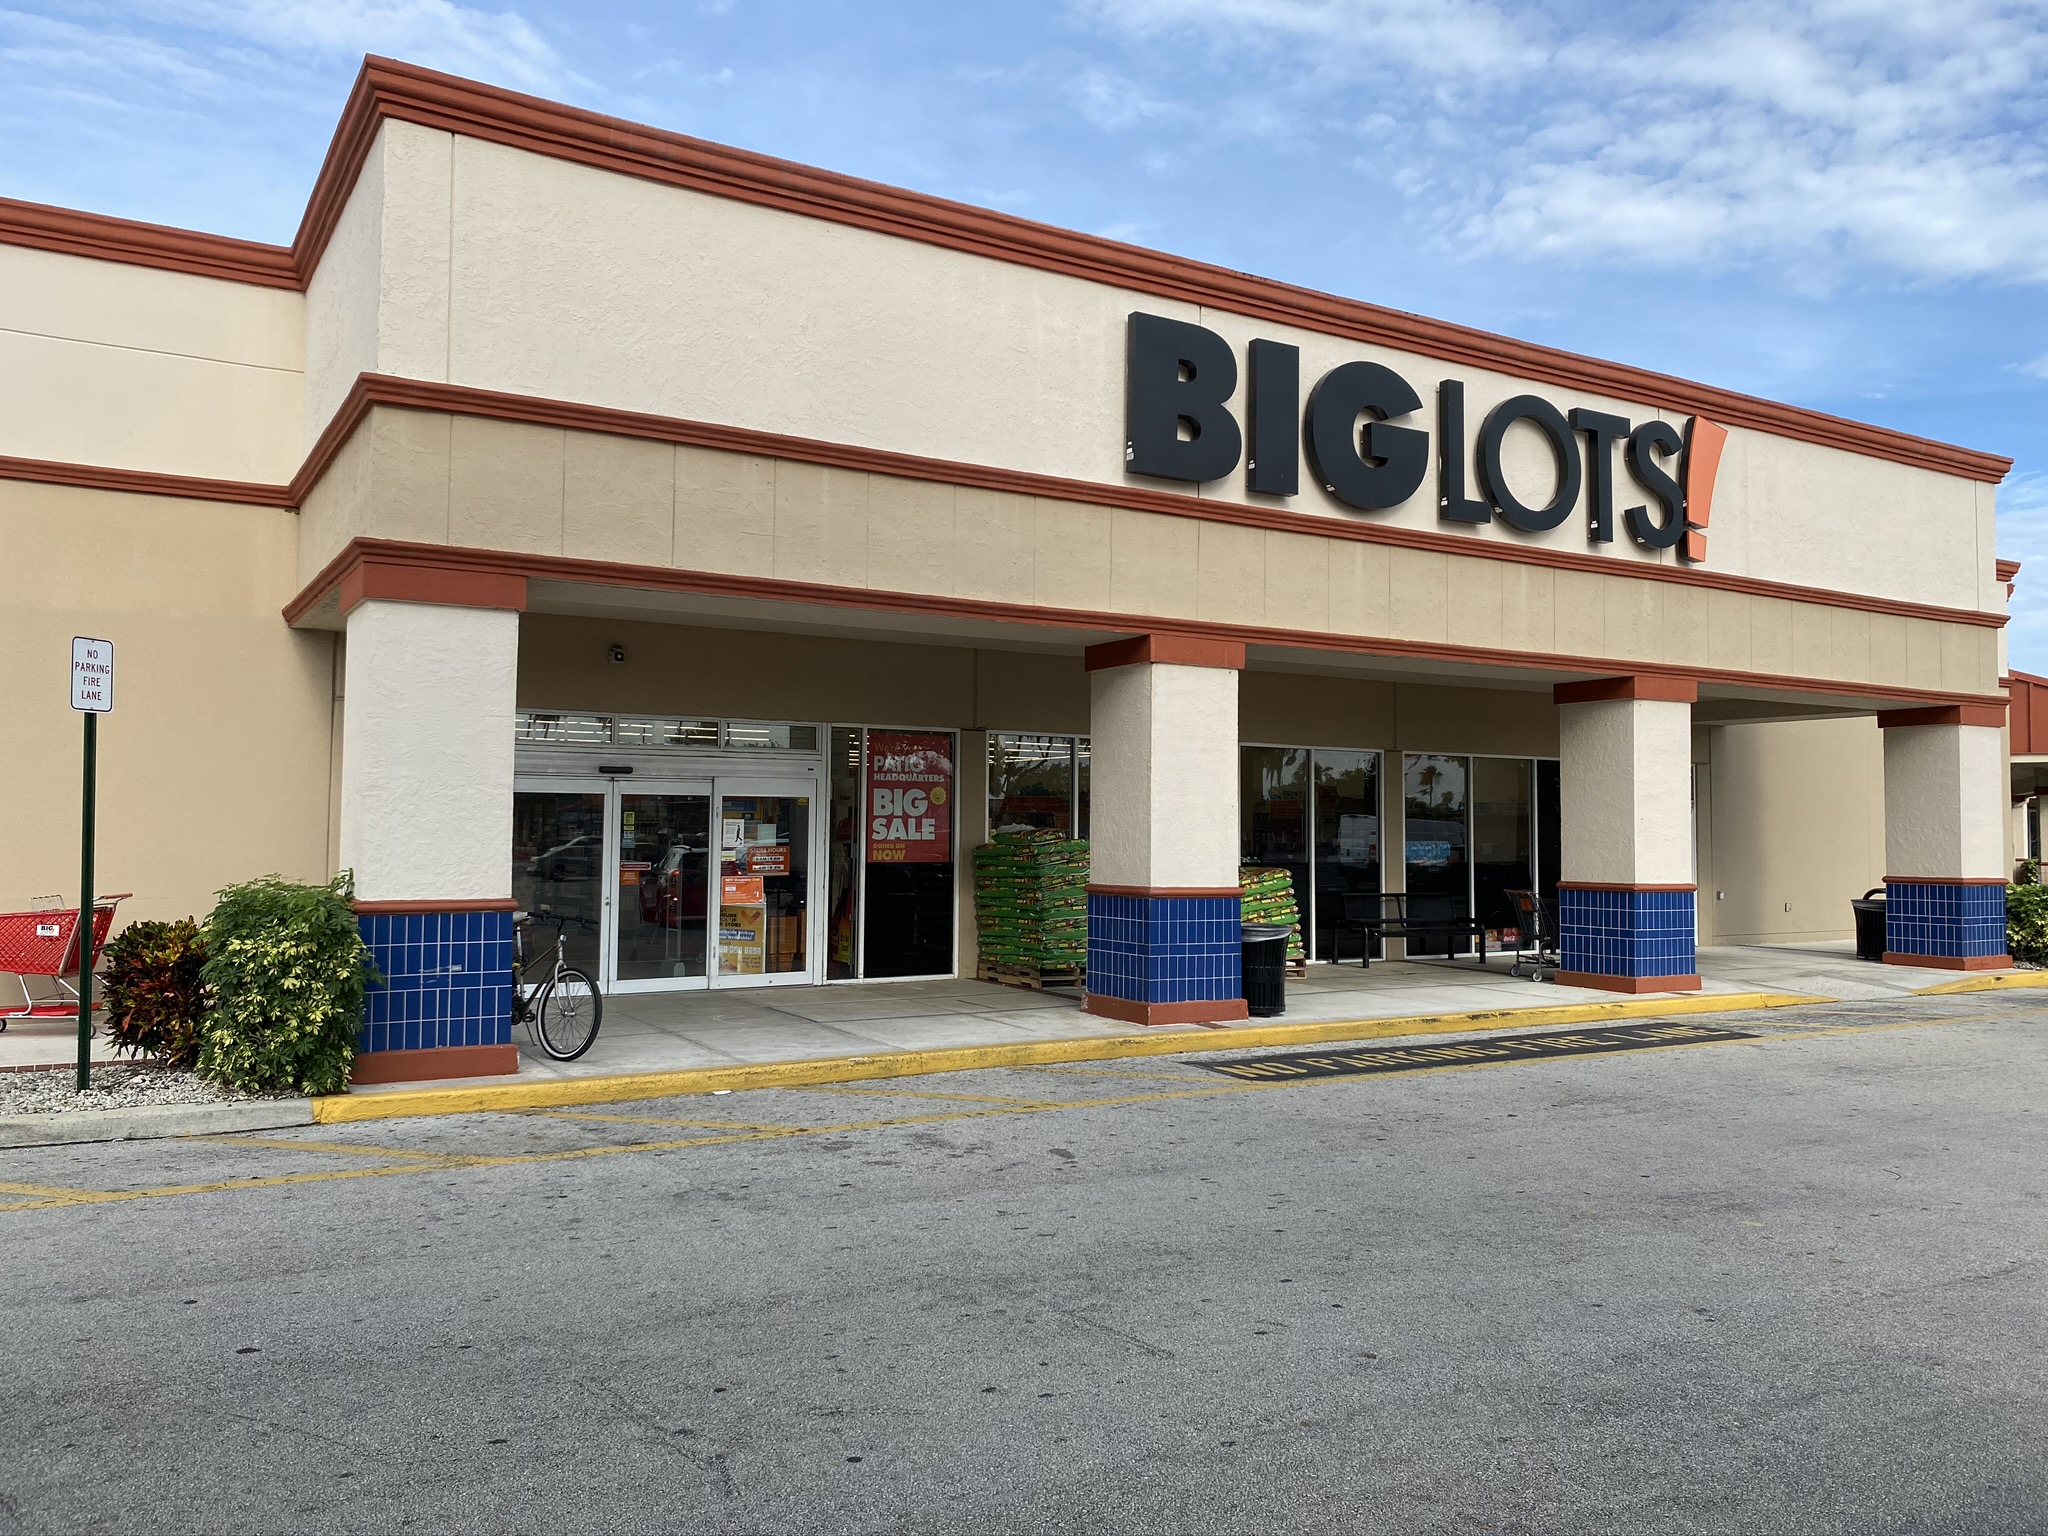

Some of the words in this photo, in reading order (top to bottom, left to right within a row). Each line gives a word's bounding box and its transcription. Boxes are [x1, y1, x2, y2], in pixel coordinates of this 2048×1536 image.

[1126, 311, 1430, 510] BIG
[1438, 379, 1729, 563] LOTS!
[87, 649, 99, 660] NO
[74, 661, 110, 675] PARKING
[83, 676, 101, 687] FIRE
[81, 690, 102, 701] LANE
[873, 755, 924, 773] PATIO
[873, 773, 945, 782] HEADQUARTERS
[873, 788, 928, 817] BIG
[871, 818, 936, 840] SALE
[872, 850, 906, 861] NOW
[1215, 1062, 1308, 1078] NO
[1296, 1045, 1511, 1070] PARKING
[1496, 1035, 1622, 1051] FIRE
[1602, 1026, 1731, 1042] LANE
